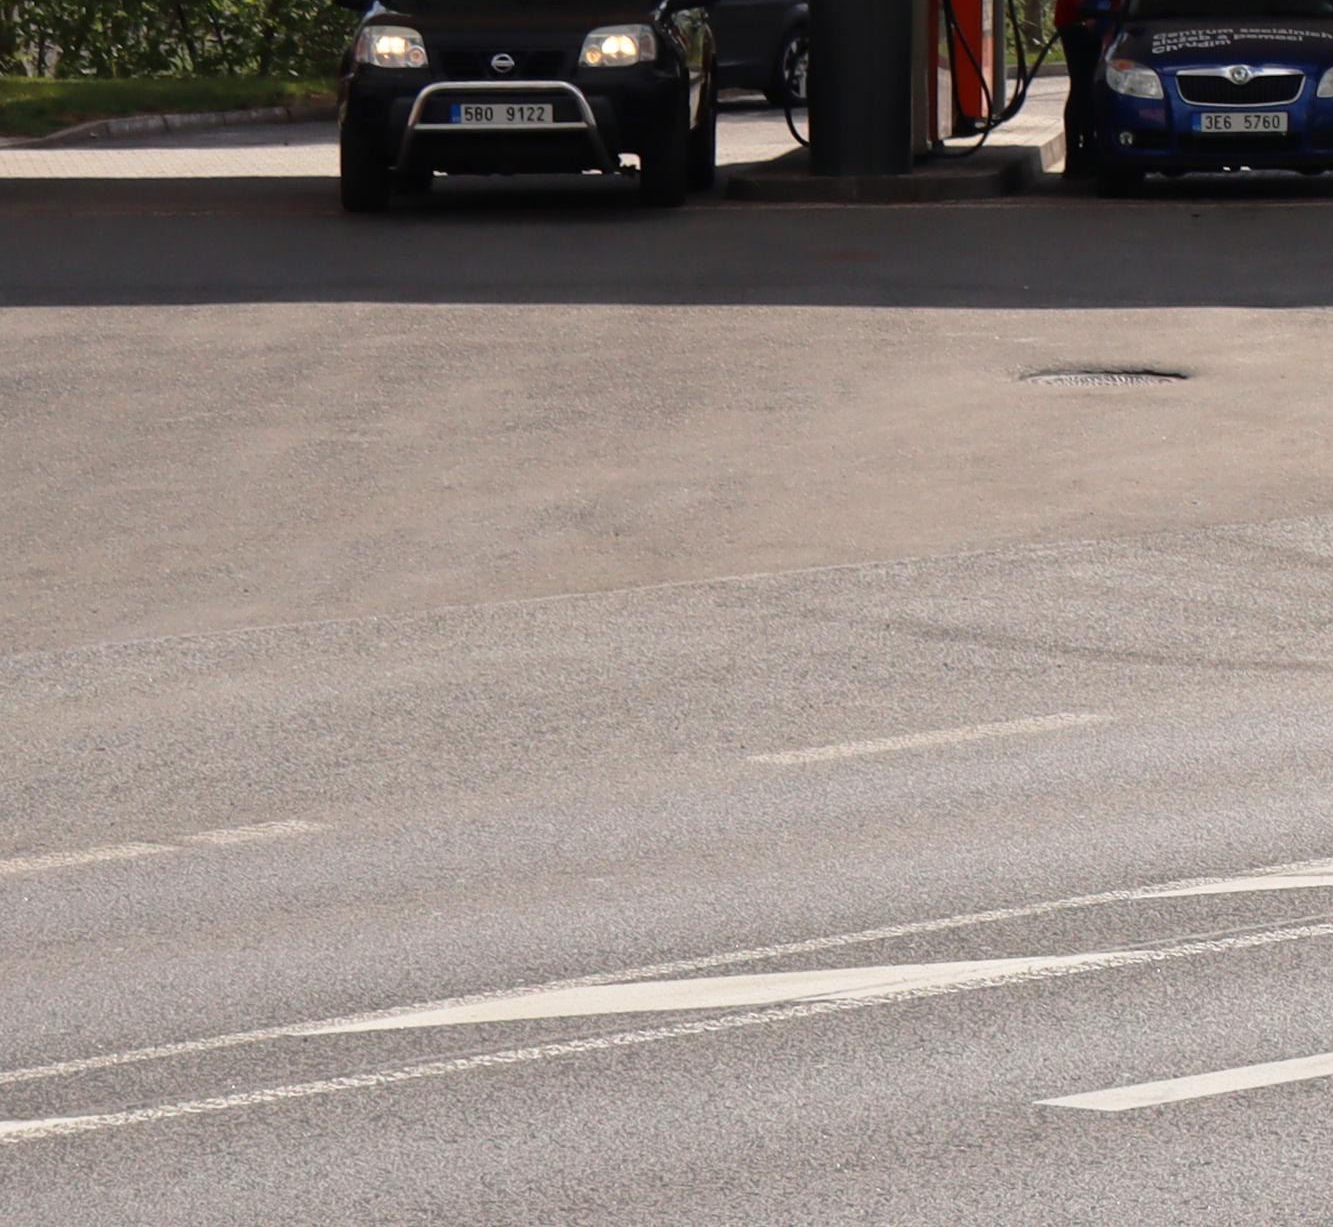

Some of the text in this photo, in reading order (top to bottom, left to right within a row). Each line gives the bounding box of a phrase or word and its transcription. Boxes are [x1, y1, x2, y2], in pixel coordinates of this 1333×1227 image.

[506, 107, 545, 122] 9122
[1205, 115, 1232, 130] 3E6
[1243, 115, 1281, 129] 5760
